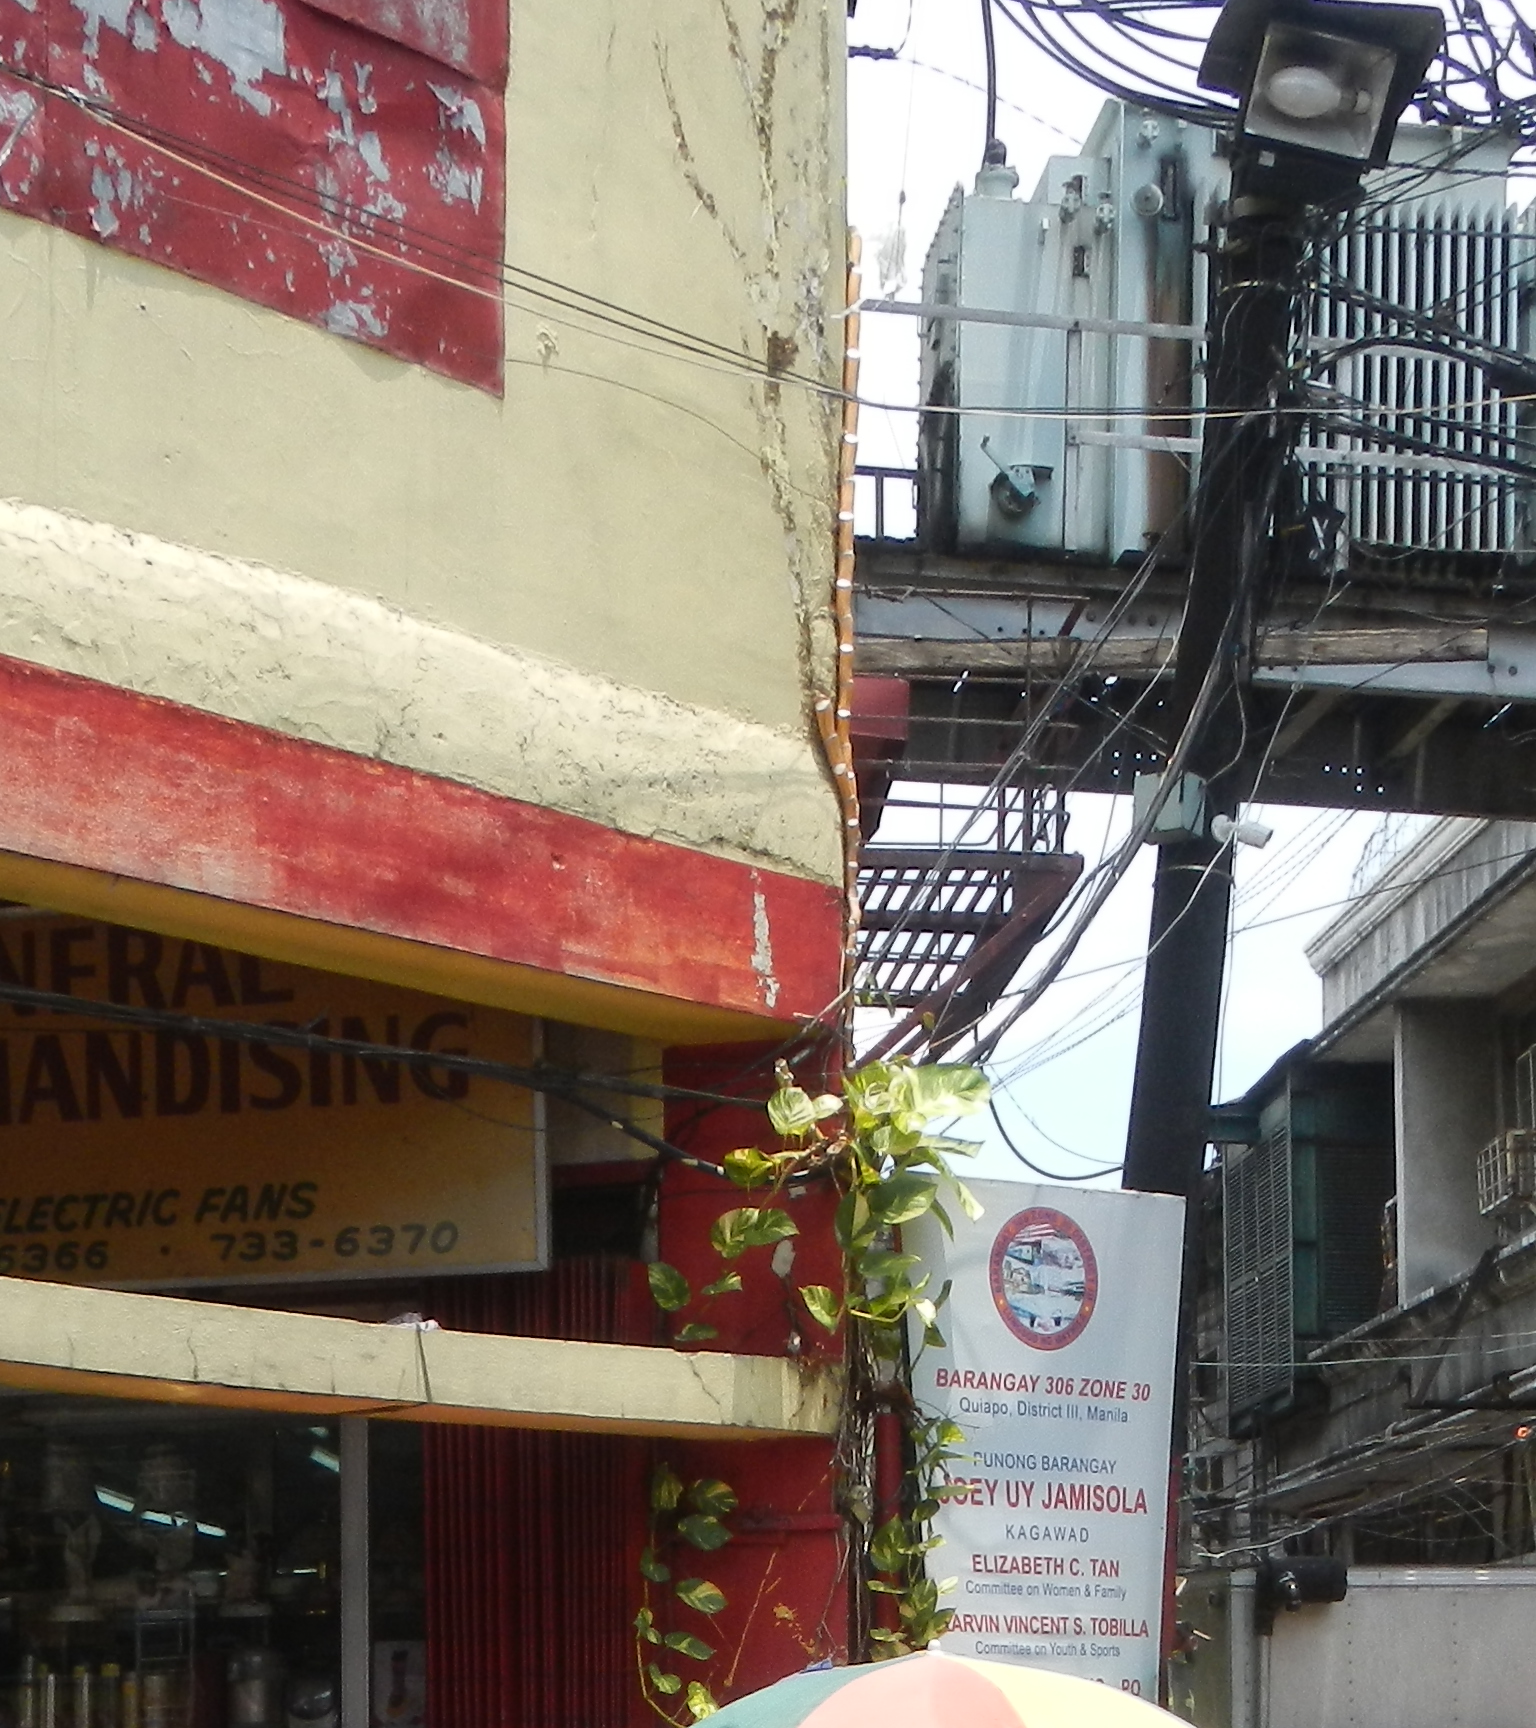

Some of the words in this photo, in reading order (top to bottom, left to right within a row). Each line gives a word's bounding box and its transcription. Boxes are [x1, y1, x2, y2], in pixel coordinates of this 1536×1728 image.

[194, 1181, 319, 1226] FANS
[212, 1221, 458, 1263] 733-6370
[936, 1368, 1042, 1393] BARANGAY
[1045, 1376, 1075, 1396] 306
[1079, 1378, 1127, 1400] ZONE
[1131, 1383, 1151, 1401] 30
[959, 1396, 1012, 1417] Quiapo,
[1017, 1400, 1063, 1419] District
[1087, 1406, 1128, 1423] Manila
[973, 1451, 1037, 1471] PUNONG
[1041, 1455, 1117, 1475] BARANGAY
[1005, 1480, 1035, 1508] UY
[1041, 1482, 1148, 1514] JAMISOLA
[1005, 1524, 1090, 1543] KAGAWAD
[972, 1554, 1064, 1576] ELIZABETH
[1069, 1558, 1085, 1577] C.
[1089, 1558, 1120, 1578] TAN
[965, 1580, 1023, 1596] Committee
[1026, 1584, 1040, 1597] on
[1042, 1583, 1082, 1598] Women
[1084, 1585, 1091, 1598] &
[1094, 1584, 1127, 1602] Family
[1004, 1615, 1069, 1635] VINCENT
[1073, 1616, 1087, 1636] S.
[1090, 1617, 1149, 1638] TOBILLA
[975, 1641, 1032, 1657] Committee
[1035, 1643, 1047, 1657] on
[1049, 1642, 1077, 1657] Youth
[1080, 1643, 1087, 1656] &
[1090, 1643, 1121, 1658] Sports
